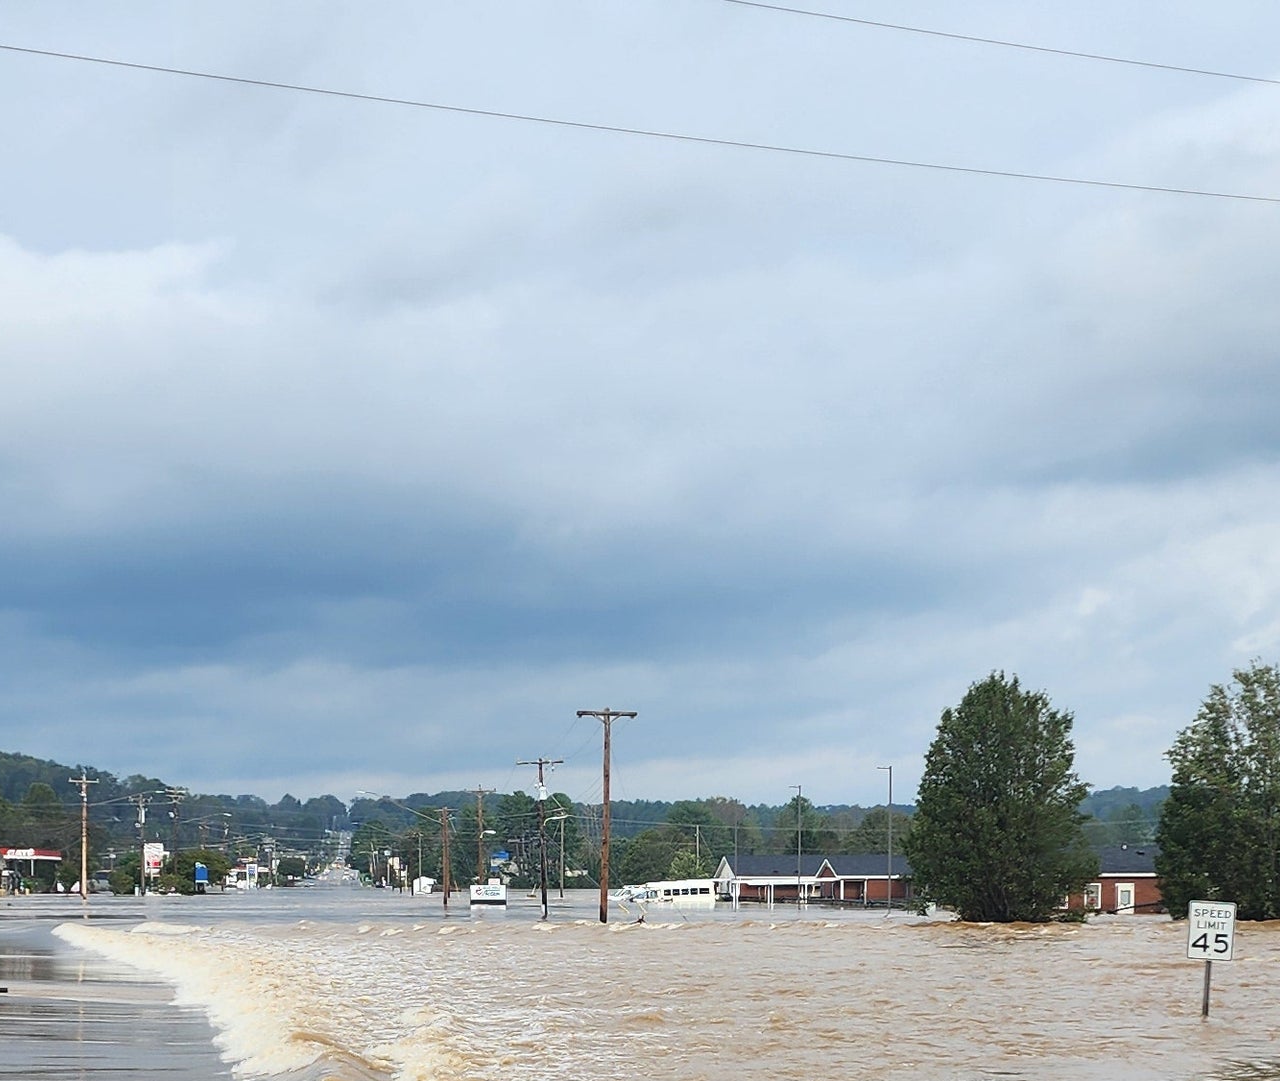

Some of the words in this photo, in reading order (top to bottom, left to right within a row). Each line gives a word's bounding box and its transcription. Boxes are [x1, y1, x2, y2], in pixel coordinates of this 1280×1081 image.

[1194, 908, 1231, 919] SPEED
[1197, 920, 1227, 930] LIMIT
[1191, 932, 1229, 954] 45
